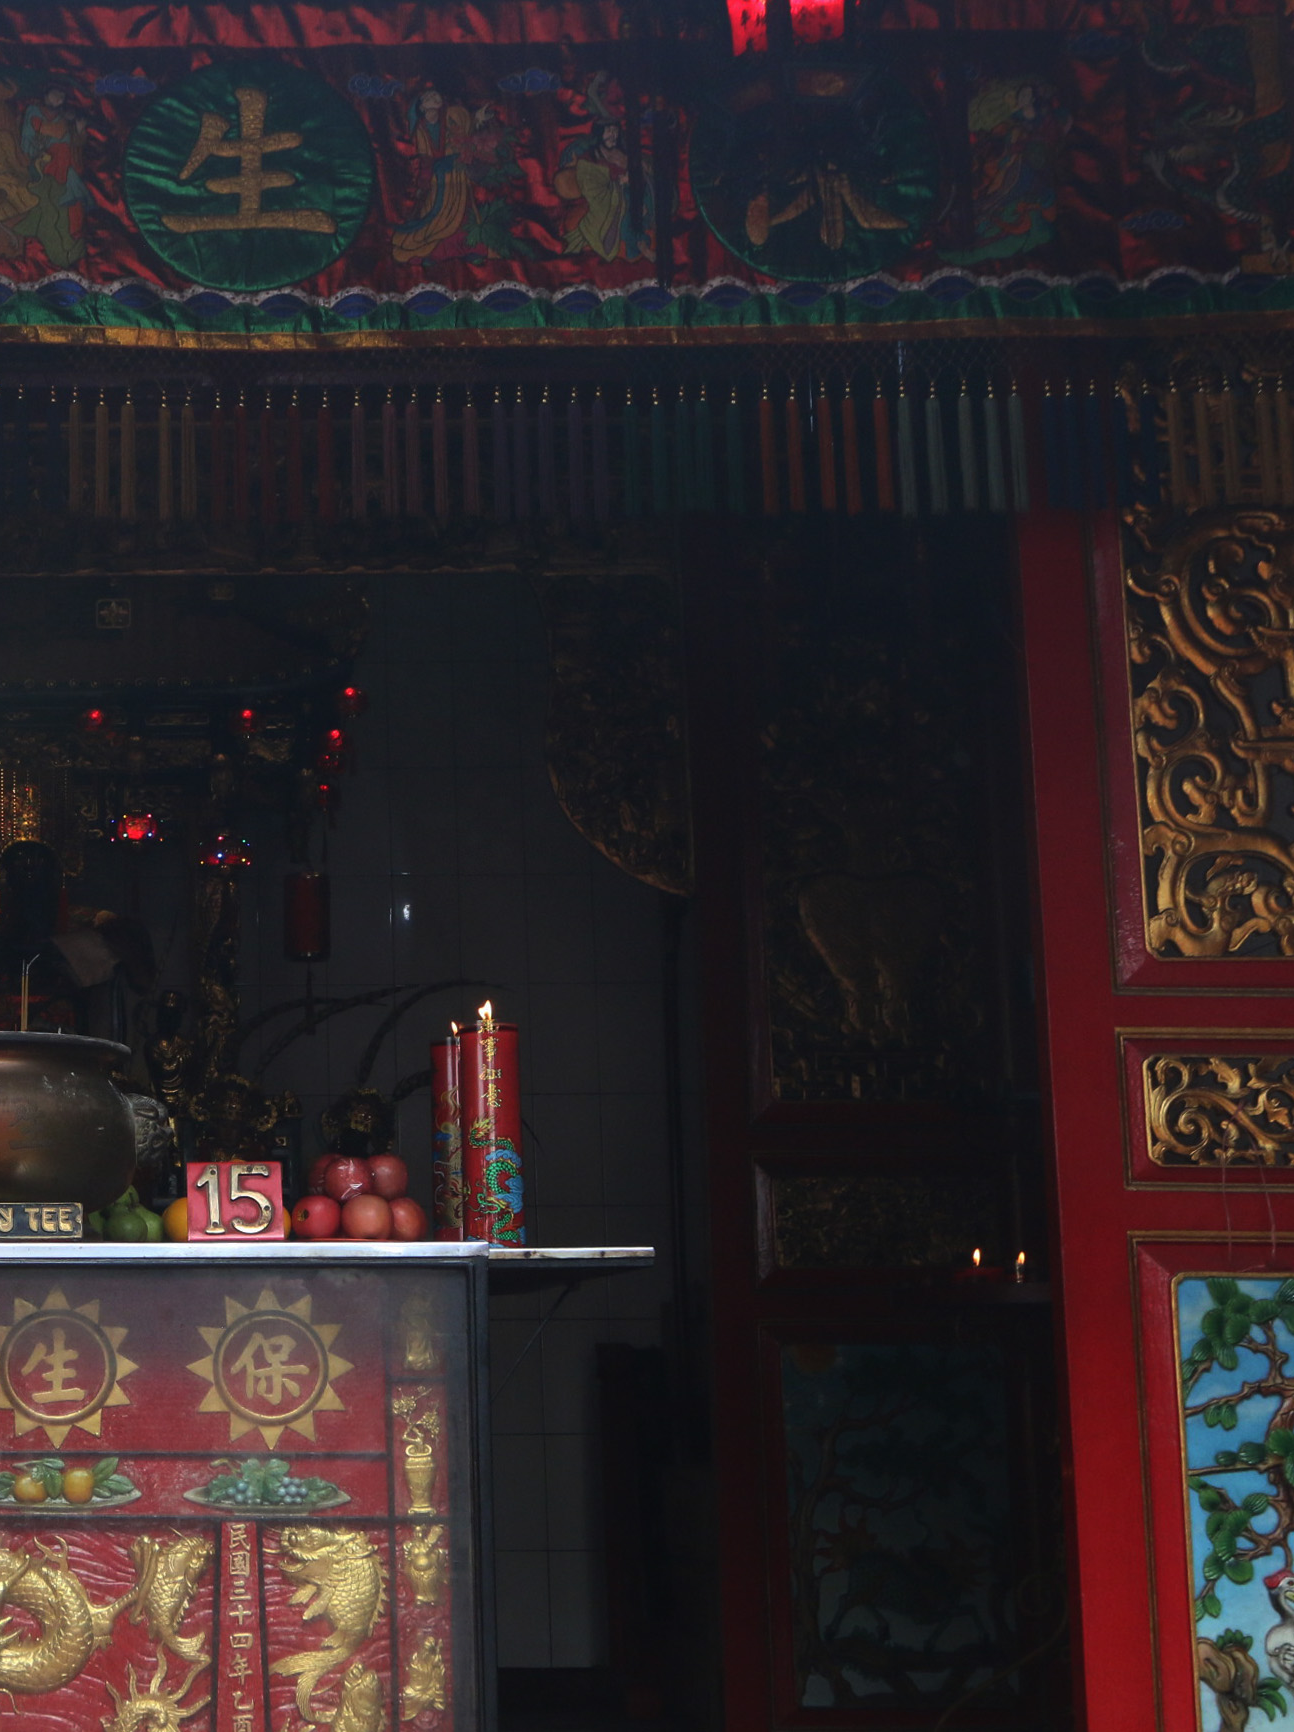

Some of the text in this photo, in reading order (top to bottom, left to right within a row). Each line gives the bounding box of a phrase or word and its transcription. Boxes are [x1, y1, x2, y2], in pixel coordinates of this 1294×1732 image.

[161, 87, 338, 235] 生
[24, 1207, 74, 1233] TEE
[196, 1164, 275, 1235] 15
[21, 1327, 86, 1404] 生
[230, 1332, 310, 1405] 保
